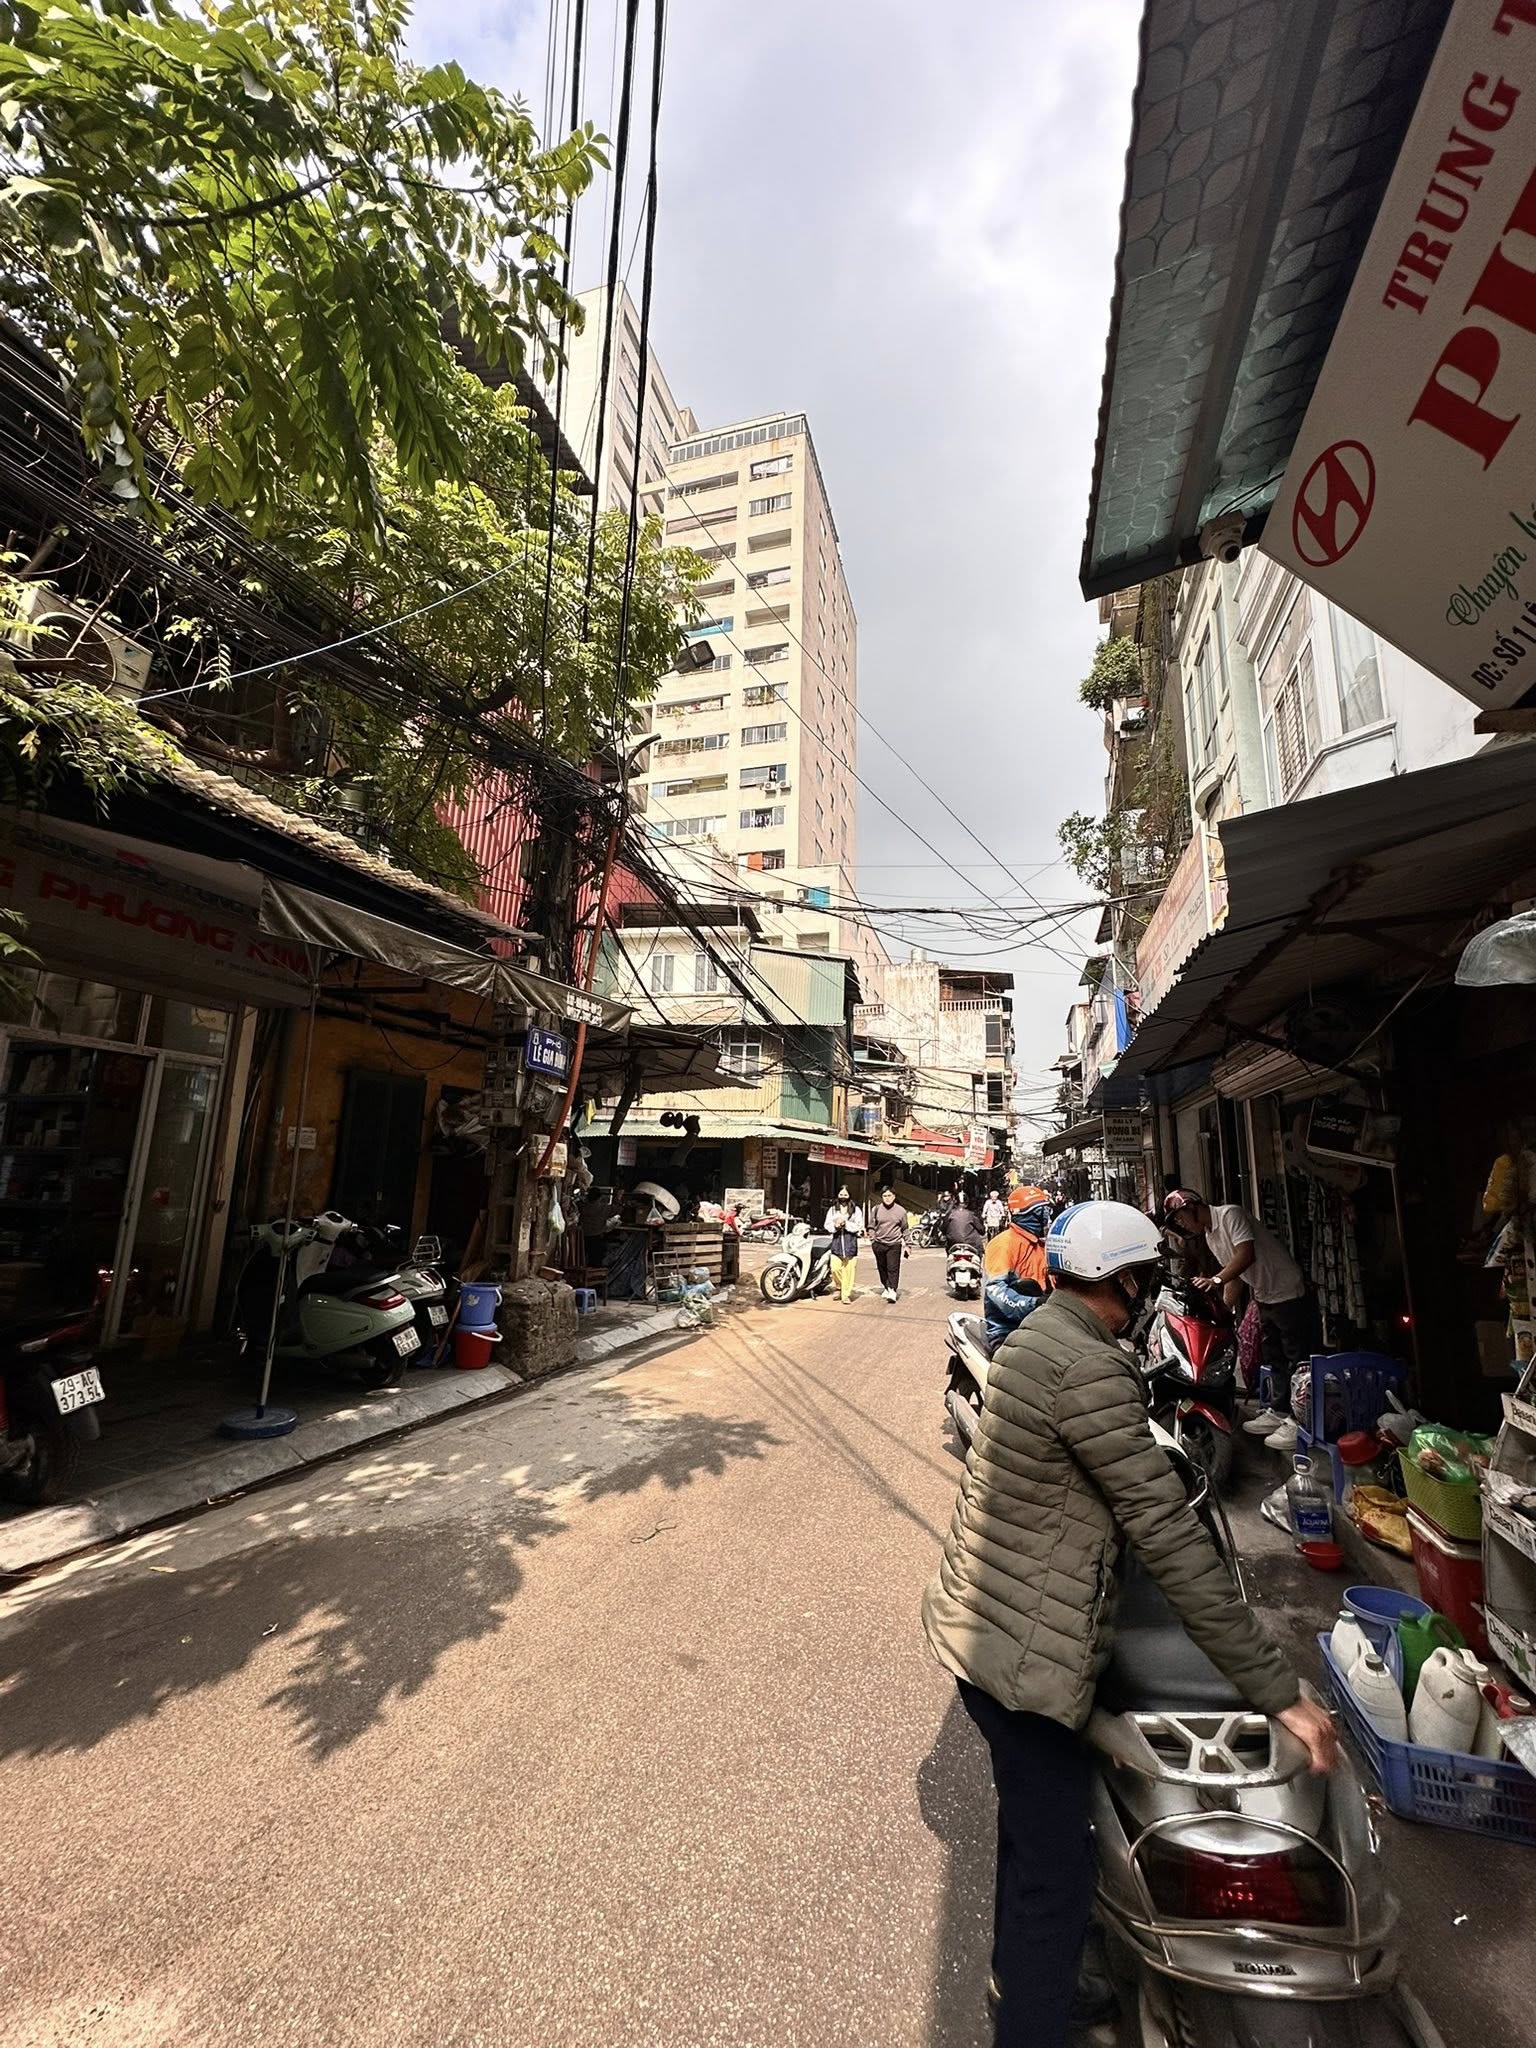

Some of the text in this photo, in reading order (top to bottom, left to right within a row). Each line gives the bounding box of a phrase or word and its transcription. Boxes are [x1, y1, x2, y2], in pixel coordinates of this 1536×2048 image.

[1381, 71, 1521, 315] TRUNG
[1446, 545, 1527, 626] Chuyên
[545, 1037, 562, 1049] PHỐ
[533, 1044, 543, 1063] LÊ
[542, 1048, 554, 1067] GIA
[60, 1371, 94, 1395] 29-AC
[1231, 1960, 1298, 1977] HONDA
